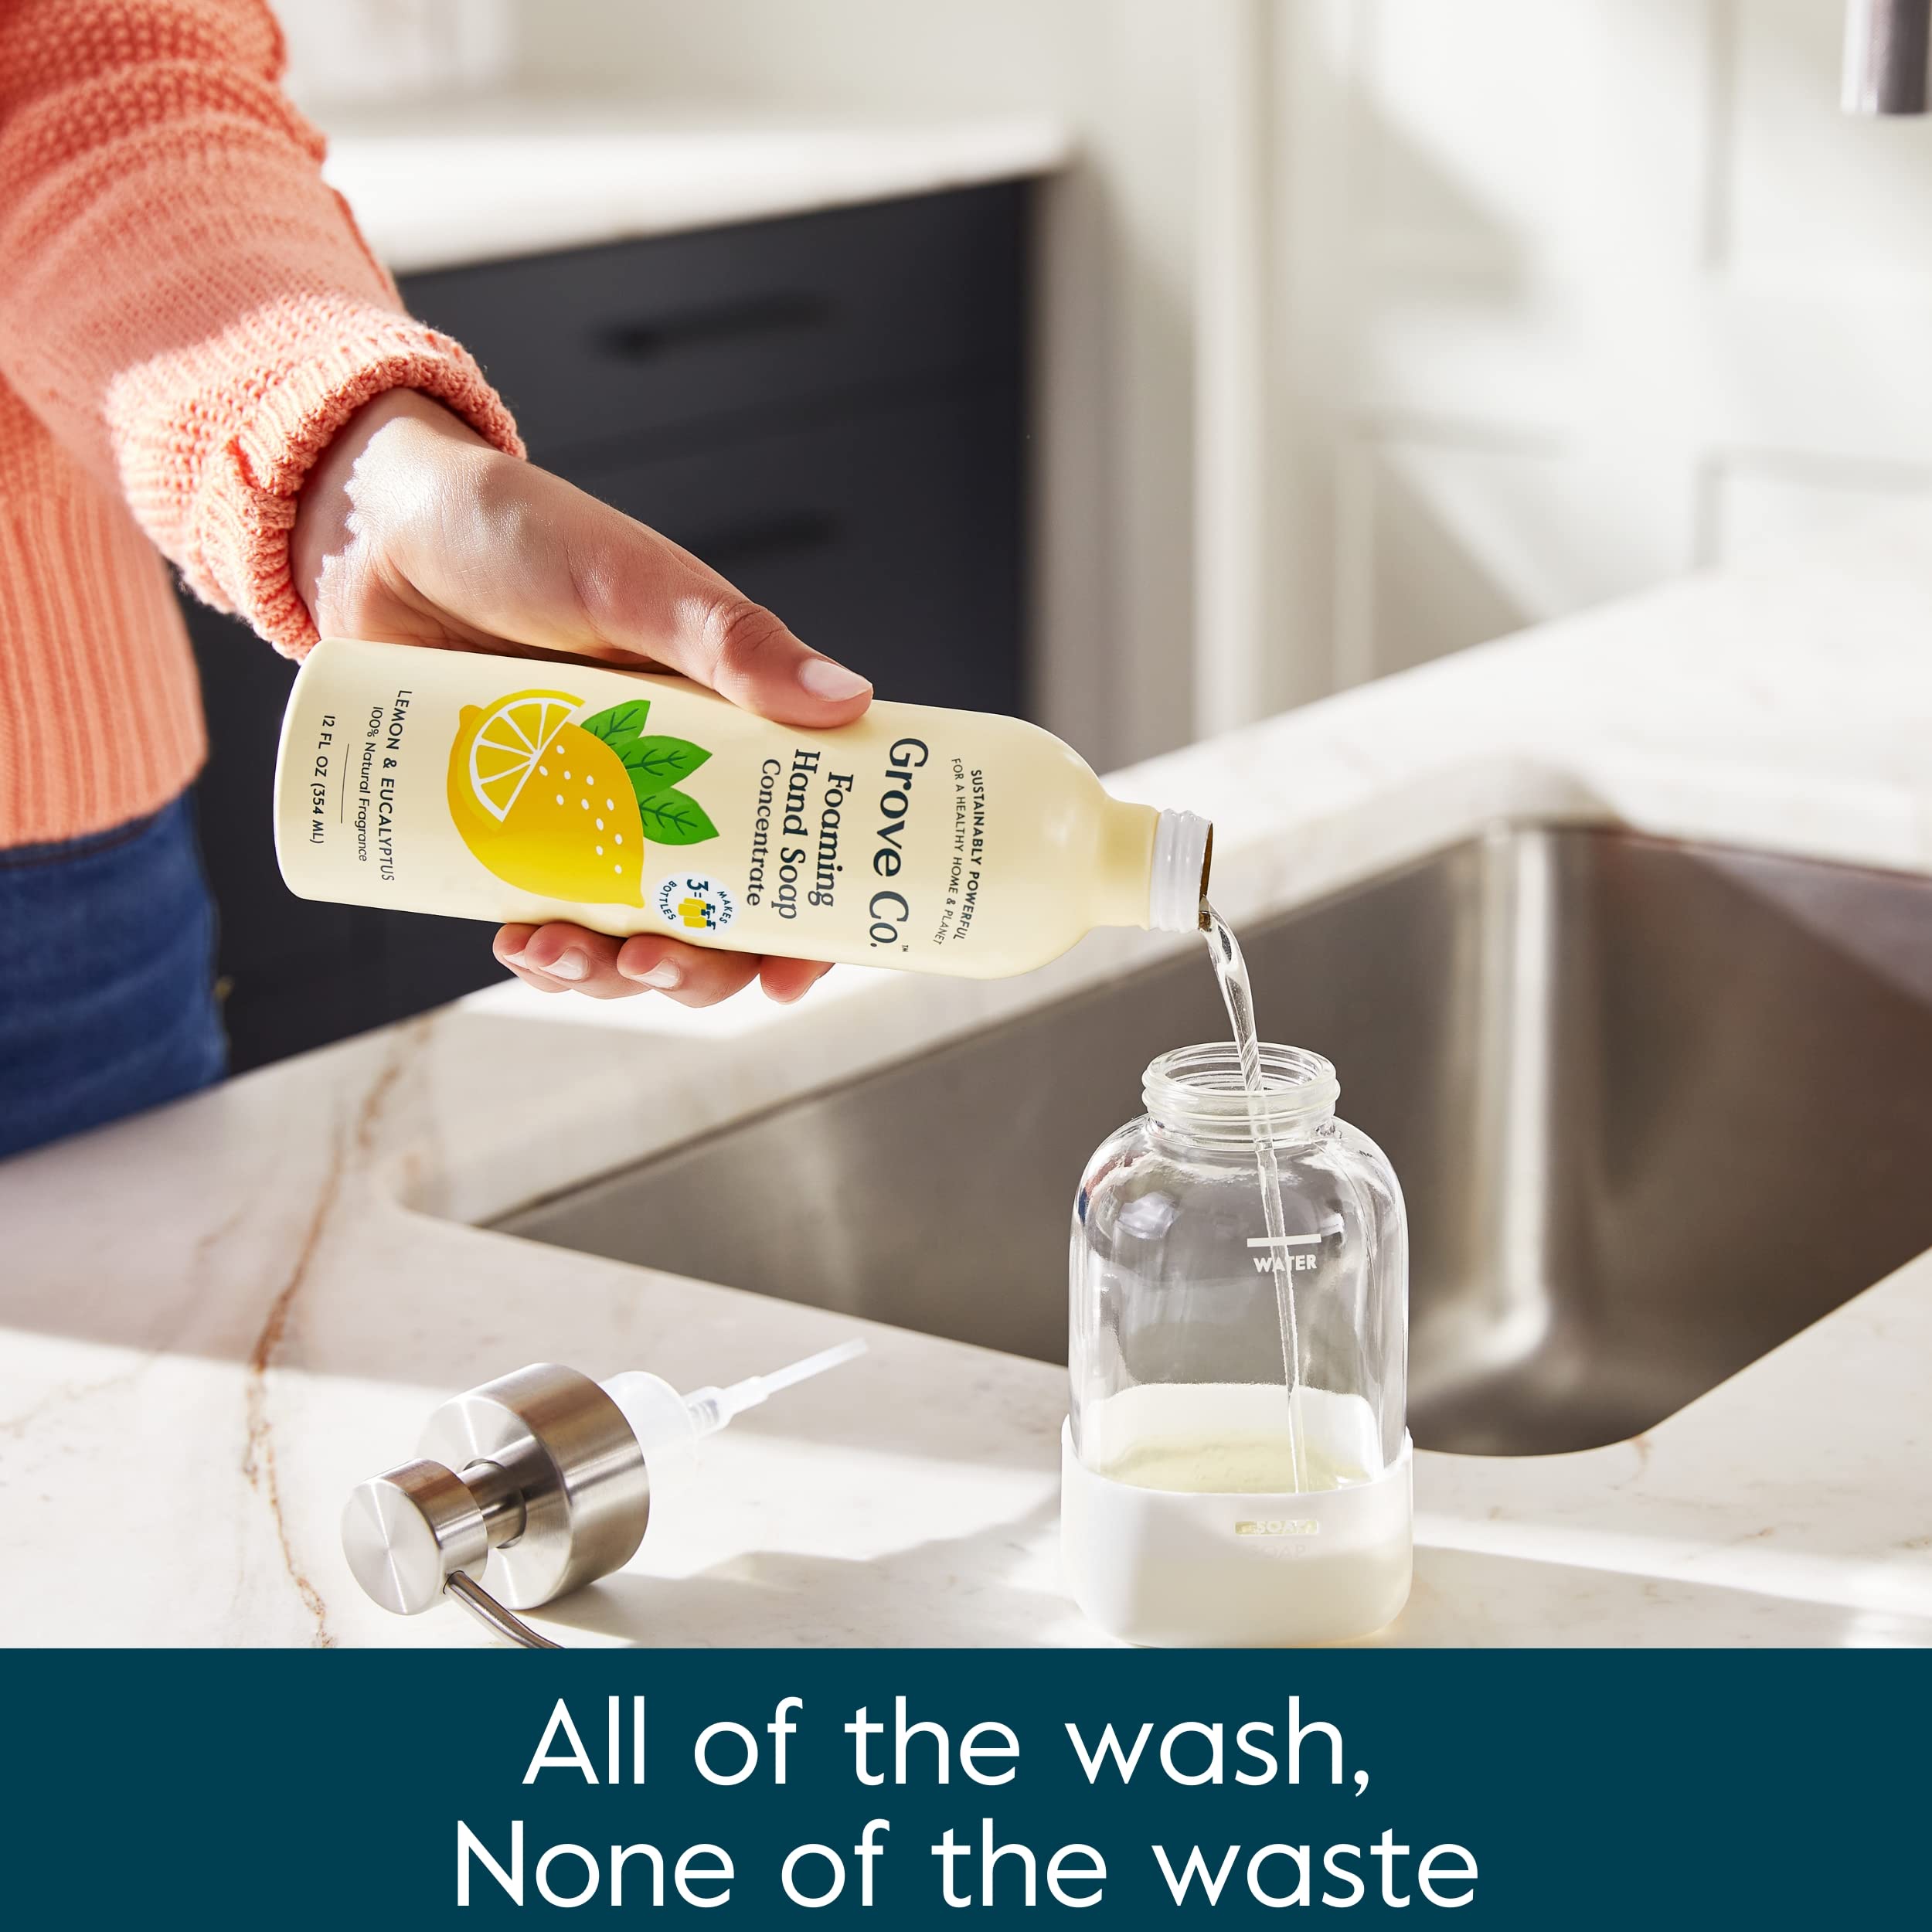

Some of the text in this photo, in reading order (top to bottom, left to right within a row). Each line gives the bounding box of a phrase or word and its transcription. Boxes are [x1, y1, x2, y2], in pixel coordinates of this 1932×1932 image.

[309, 715, 336, 844] 12 FL OZ (354 ML)
[354, 706, 384, 862] 100% Natural Fragrance
[378, 689, 413, 881] LEMON & EUCALYPTUS
[872, 737, 929, 877] Grove
[951, 757, 964, 781] FOR
[955, 784, 965, 792] A
[747, 759, 781, 906] Concentrate
[770, 748, 821, 920] Hand Soap
[808, 771, 854, 907] Foaming
[953, 769, 985, 940] SUSTAINABLY POWERFUL
[954, 796, 966, 852] HEALTHY
[658, 880, 678, 920] BOTTLES
[716, 890, 733, 924] MAKES
[948, 856, 963, 894] HOME
[933, 909, 954, 945] PLANET
[1253, 1254, 1317, 1273] WATER
